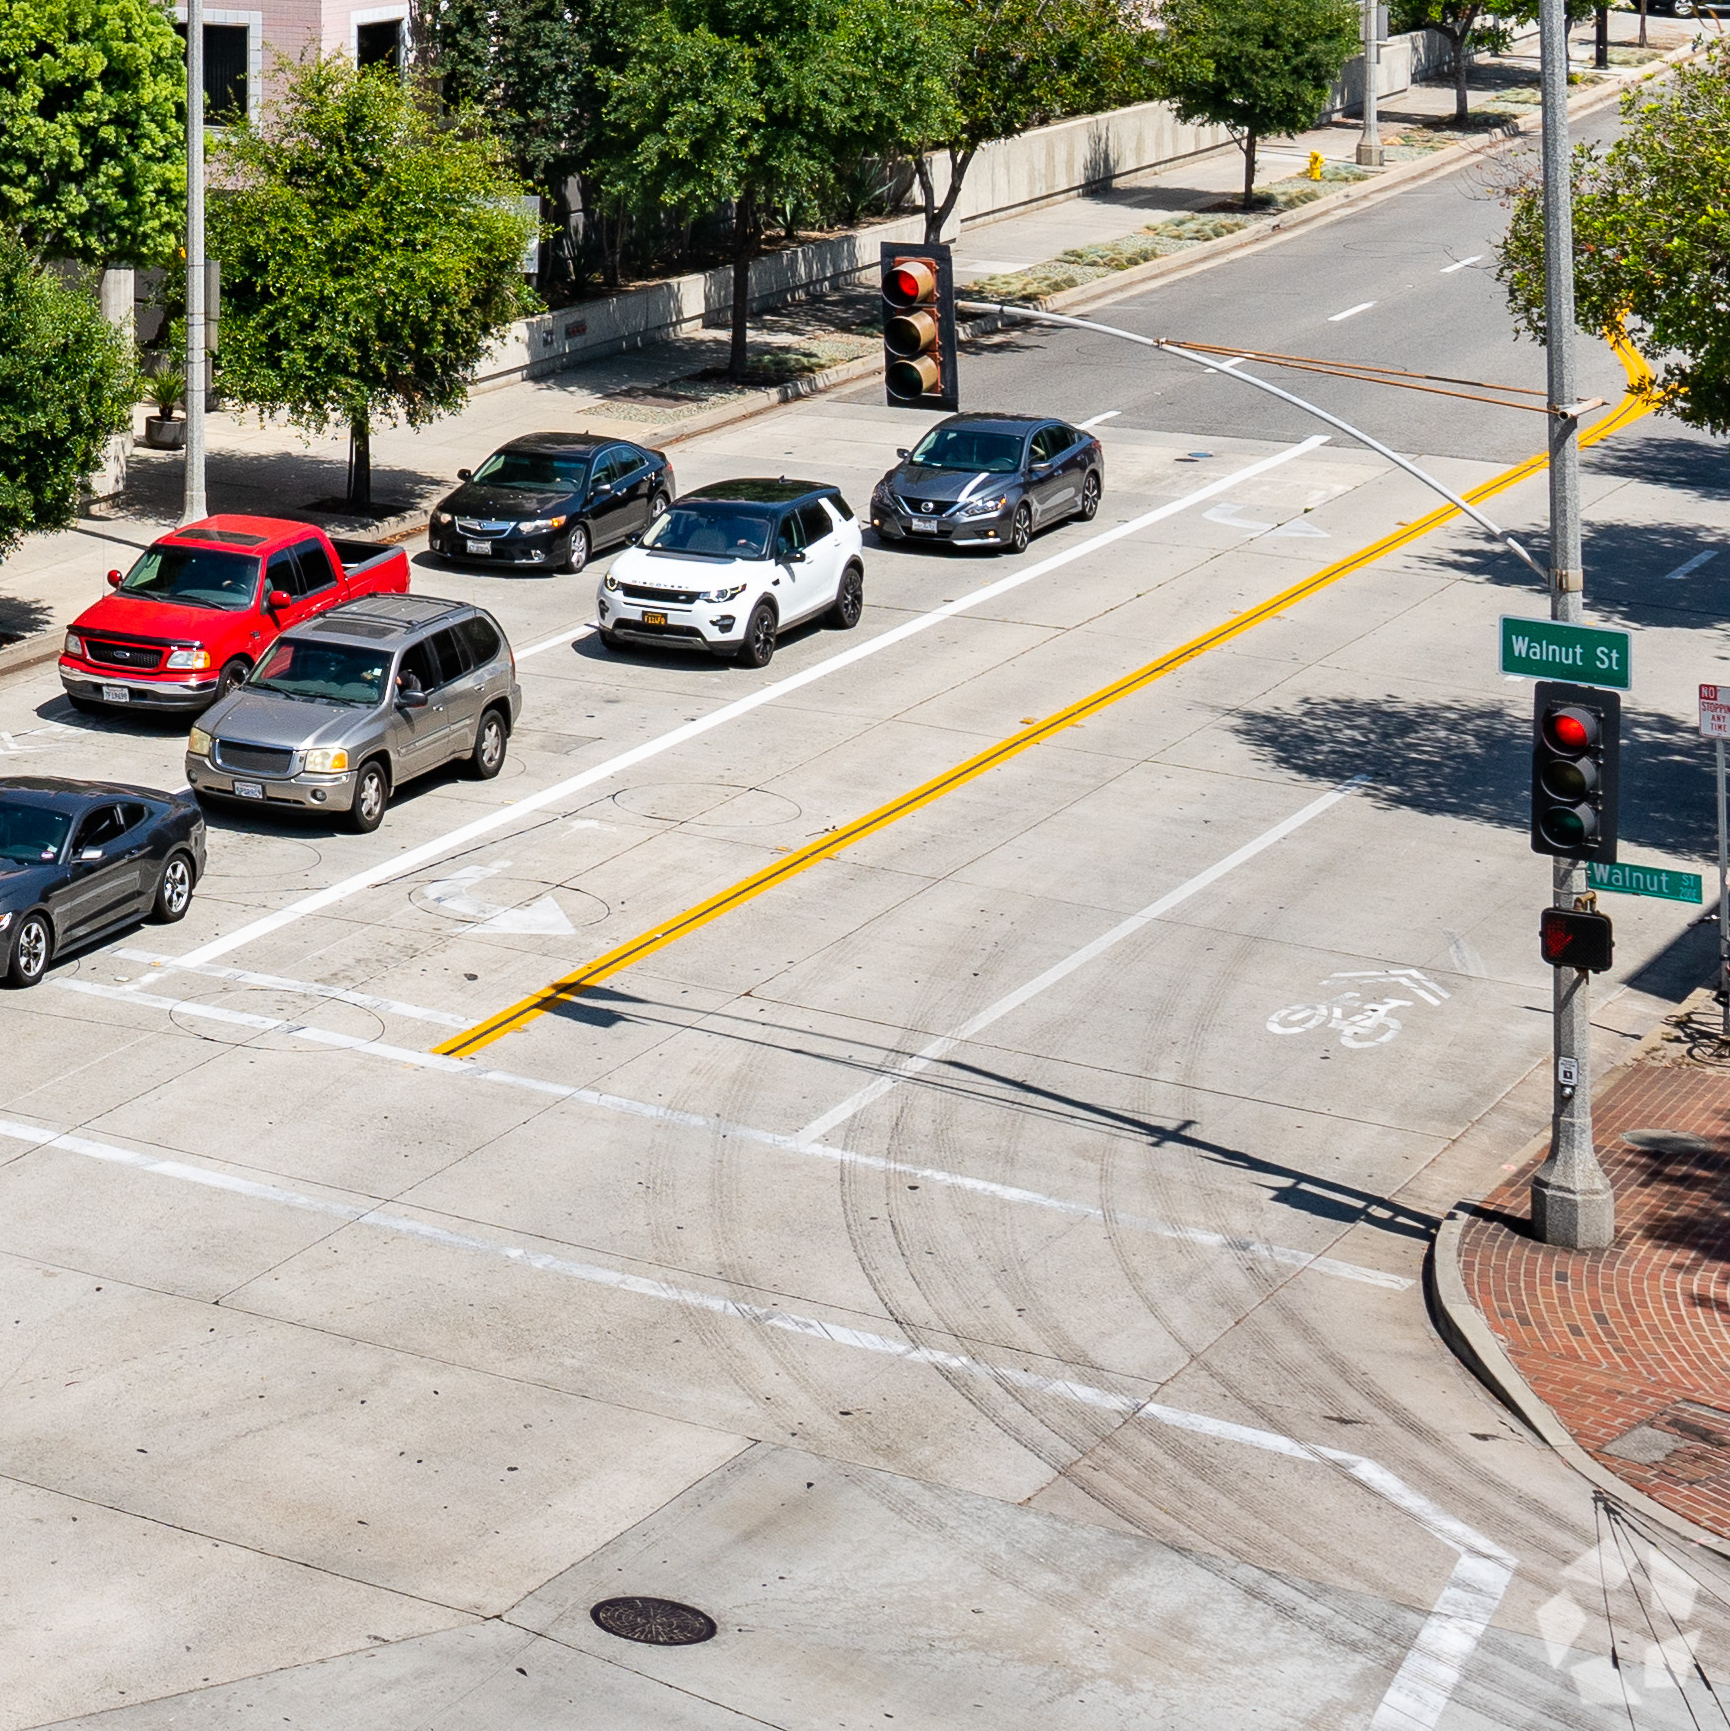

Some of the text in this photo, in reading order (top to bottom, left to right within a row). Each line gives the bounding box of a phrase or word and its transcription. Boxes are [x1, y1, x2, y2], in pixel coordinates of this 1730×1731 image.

[1511, 634, 1620, 671] Walnut St
[1701, 686, 1715, 699] NO
[1711, 714, 1726, 723] ANY
[1710, 723, 1727, 733] TIME
[1593, 862, 1695, 893] Walnut ST
